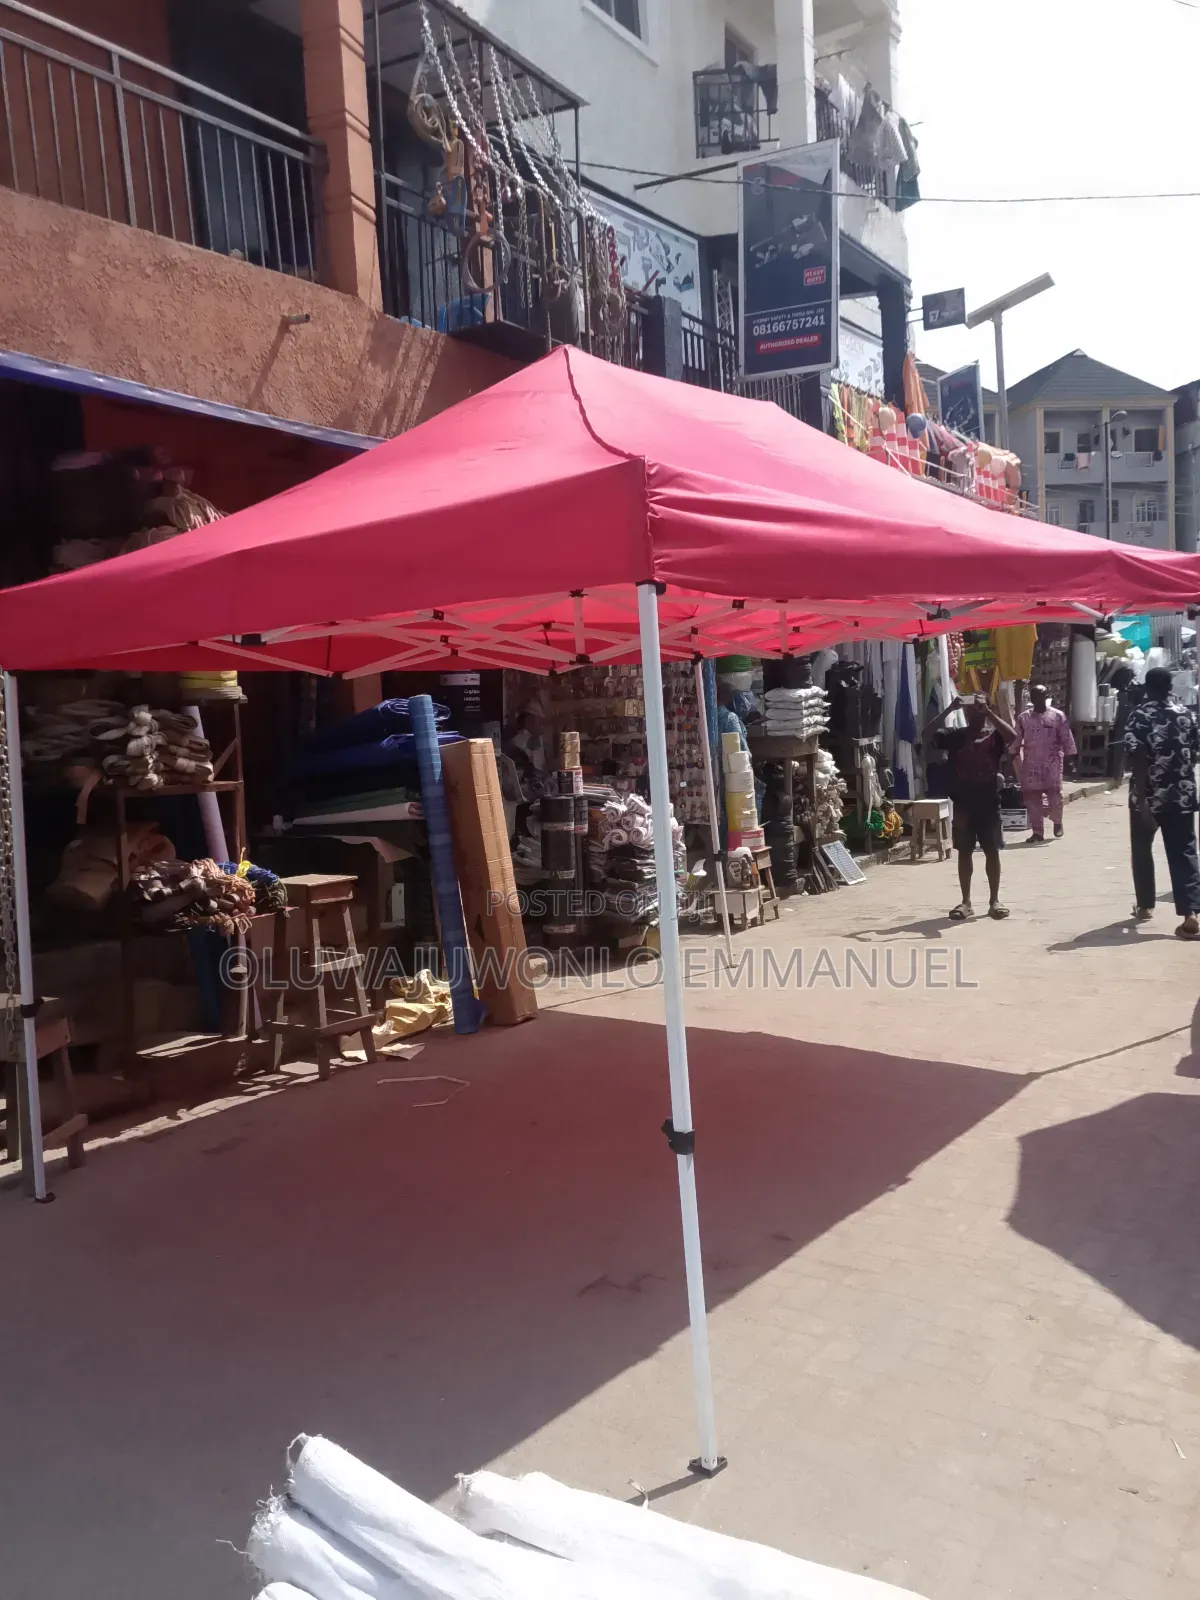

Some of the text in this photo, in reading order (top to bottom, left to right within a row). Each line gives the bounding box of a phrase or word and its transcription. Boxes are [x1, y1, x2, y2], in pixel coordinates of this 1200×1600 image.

[752, 314, 826, 336] 08166757241
[759, 335, 819, 350] AUTHORIZED DEALER
